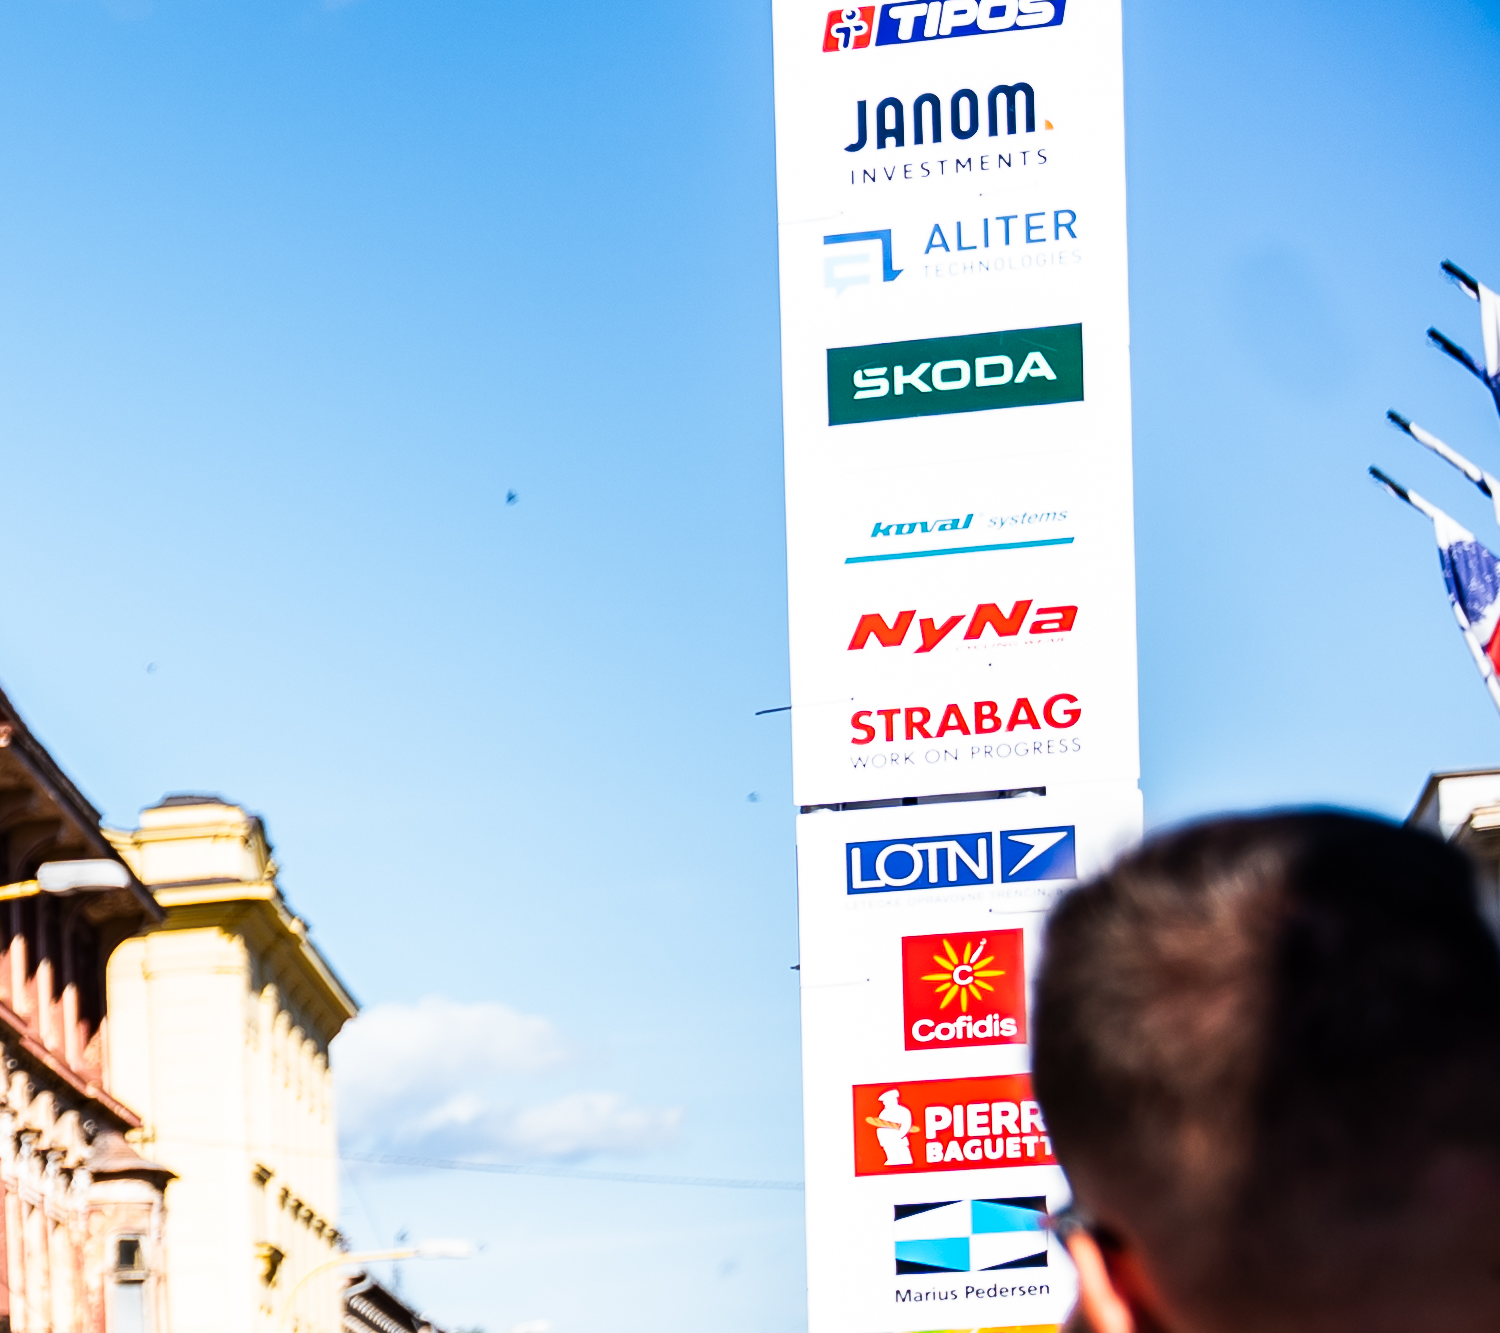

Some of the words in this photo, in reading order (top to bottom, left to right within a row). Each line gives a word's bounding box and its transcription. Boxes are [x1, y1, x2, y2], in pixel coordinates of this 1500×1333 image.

[888, 0, 1056, 41] TIPOS
[850, 148, 1049, 186] INVESTMENTS
[923, 208, 1079, 255] ALITER
[923, 248, 1083, 280] TECHNOLOGIES
[987, 508, 1069, 532] systems
[846, 598, 1079, 655] NyNa
[850, 692, 1083, 746] STRABAG
[849, 747, 916, 770] WORK
[924, 747, 960, 765] ON
[970, 736, 1082, 760] PROGRESS
[850, 836, 989, 889] LOTN
[911, 1013, 1019, 1043] Cofidis
[924, 1099, 1047, 1140] PIERR
[925, 1136, 1054, 1165] BAGUETT
[895, 1285, 959, 1304] Marius
[964, 1282, 1051, 1300] Pedersen
